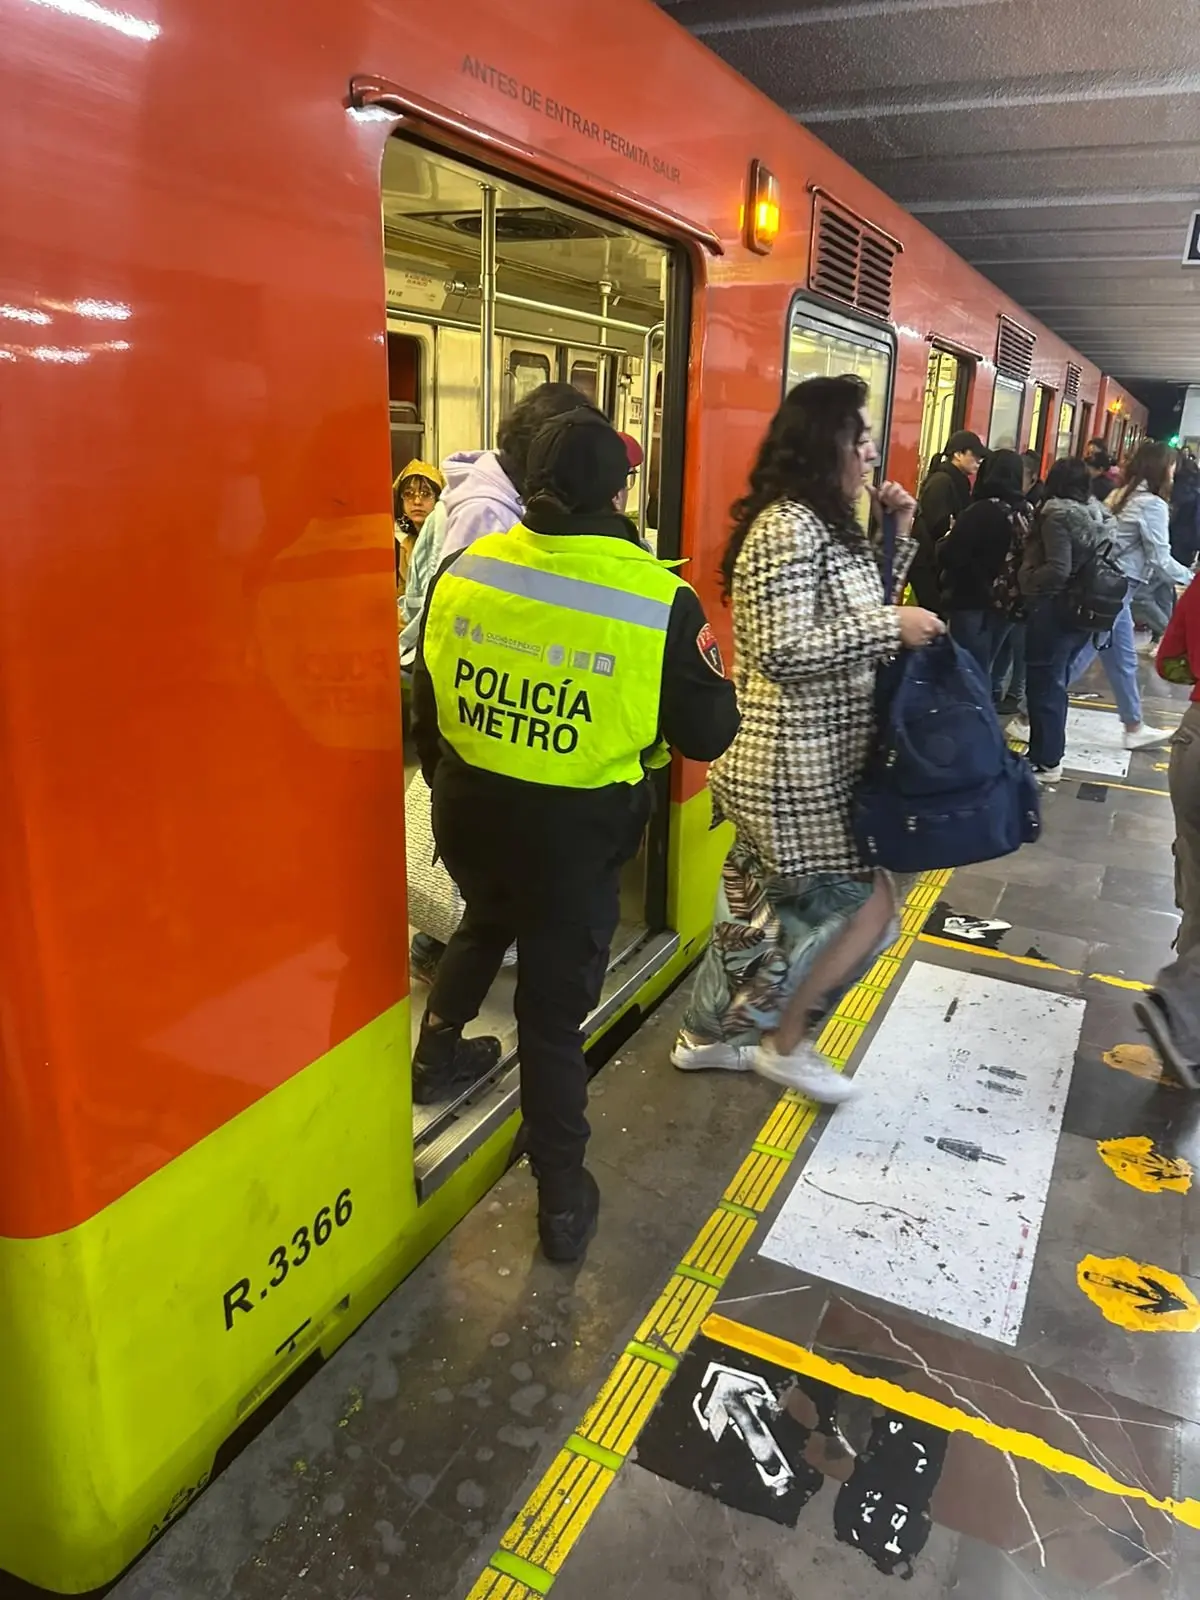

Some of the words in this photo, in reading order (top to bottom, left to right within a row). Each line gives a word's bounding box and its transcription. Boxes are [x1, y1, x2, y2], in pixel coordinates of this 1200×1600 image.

[462, 54, 518, 99] ANTES
[521, 85, 541, 111] DE
[545, 98, 600, 142] ENTRAR
[603, 129, 650, 168] PERMITA
[652, 156, 681, 185] SALIR
[454, 657, 593, 723] POLICÍA
[458, 695, 579, 755] METRO
[222, 1188, 353, 1331] R.3366
